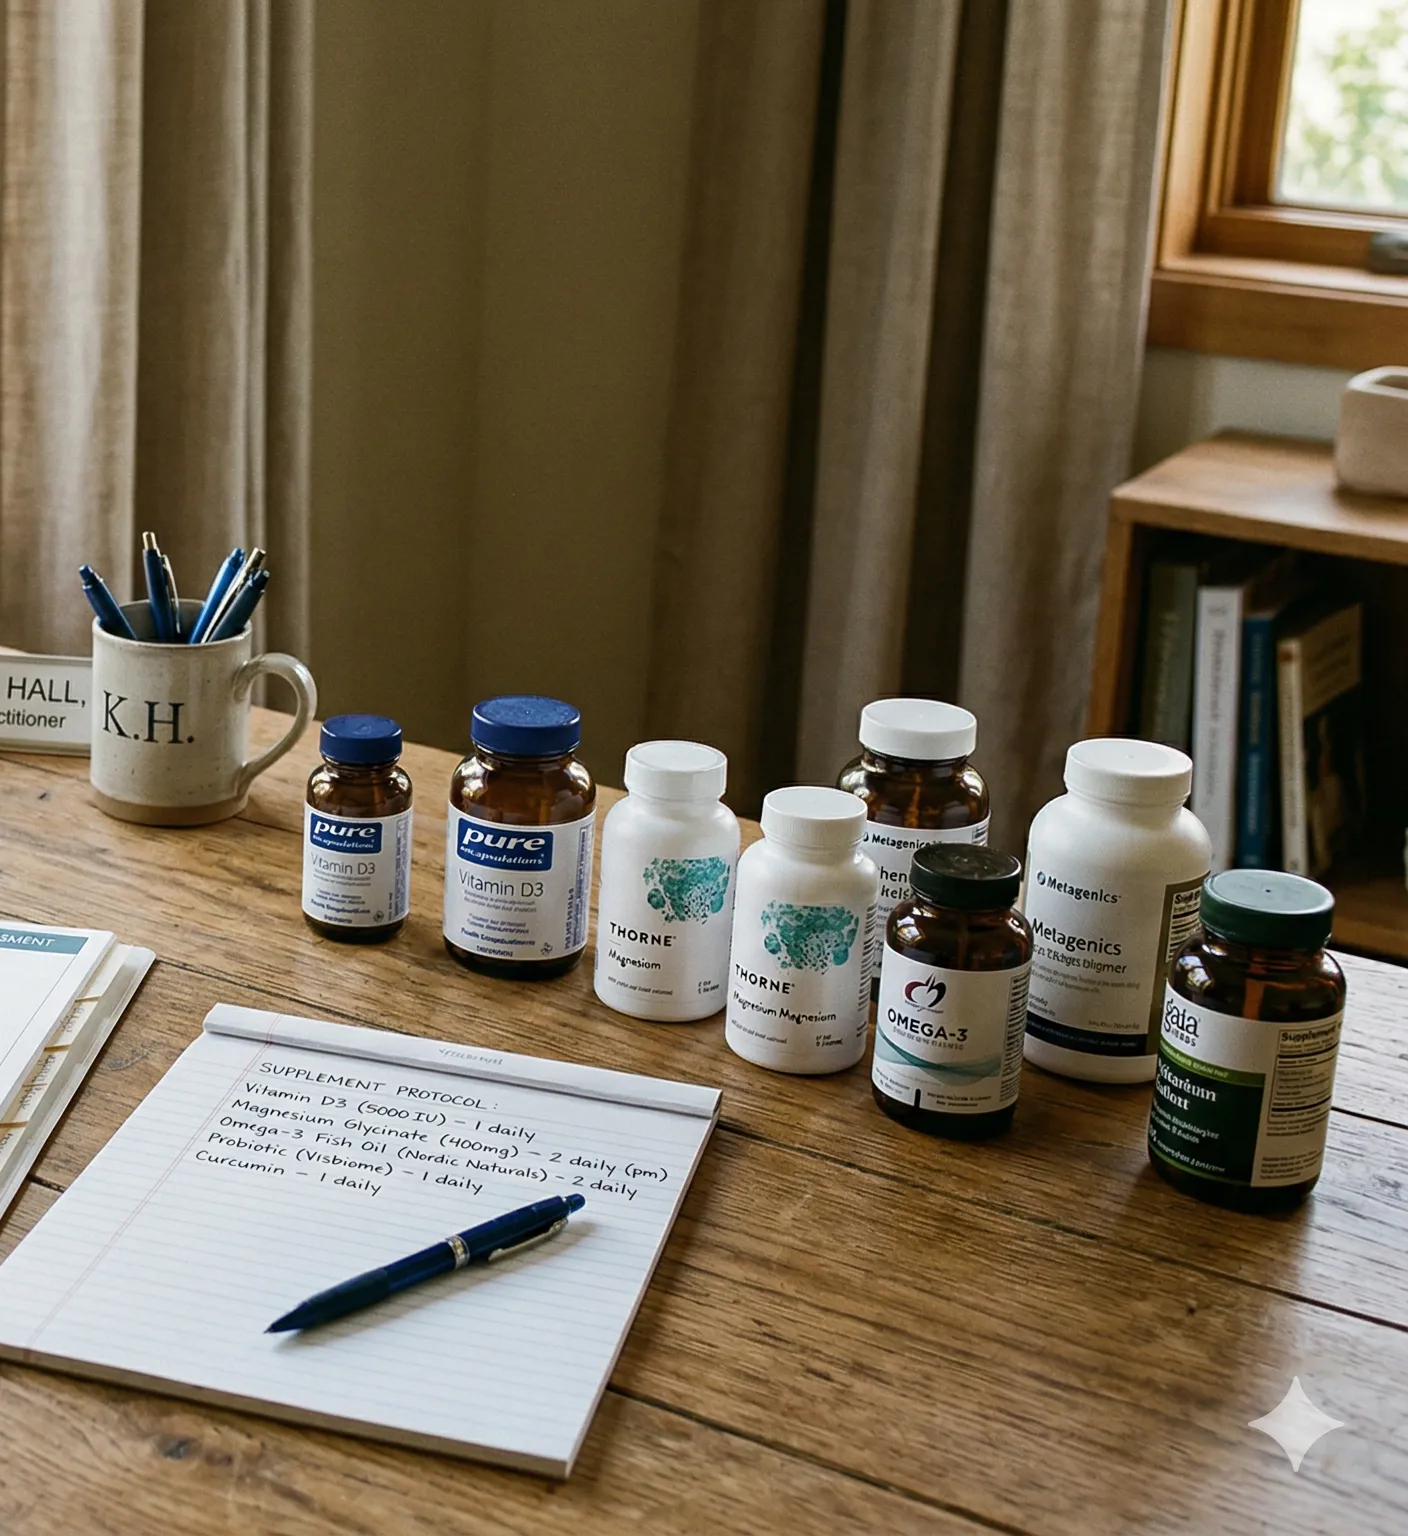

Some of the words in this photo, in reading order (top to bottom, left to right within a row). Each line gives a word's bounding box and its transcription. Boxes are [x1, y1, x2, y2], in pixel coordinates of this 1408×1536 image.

[7, 677, 87, 708] HALL,
[102, 690, 196, 745] K.H.
[314, 821, 376, 838] pure
[462, 827, 545, 850] pure
[357, 863, 376, 875] D3
[458, 868, 514, 897] Vitamin
[521, 882, 544, 898] D3
[1046, 876, 1118, 904] Metagenics
[610, 921, 673, 947] THORNE
[1032, 918, 1122, 956] Metagenics
[735, 963, 791, 994] THORNE
[887, 1008, 968, 1042] OMEGA-3
[259, 1062, 386, 1092] SUPPLEMENT
[245, 1082, 311, 1104] Vitamin
[321, 1096, 347, 1109] D3
[487, 1122, 536, 1143] daily
[231, 1099, 334, 1127] Magnesium
[344, 1118, 428, 1143] Glycinate
[439, 1133, 519, 1159] (400mg)
[549, 1152, 562, 1163] 2
[569, 1155, 617, 1177] daily
[624, 1163, 669, 1183] (pm)
[195, 1149, 285, 1177] Curcumin
[333, 1175, 383, 1197] daily
[207, 1132, 288, 1157] Probiotic
[295, 1148, 394, 1177] (Visbiome)
[435, 1174, 484, 1196] daily
[220, 1116, 304, 1140] Omega-3
[315, 1133, 353, 1149] Fish
[361, 1140, 388, 1155] Oil
[397, 1146, 459, 1167] (Nordic
[465, 1158, 549, 1182] Naturals)
[571, 1175, 585, 1188] 2
[589, 1177, 638, 1201] daily
